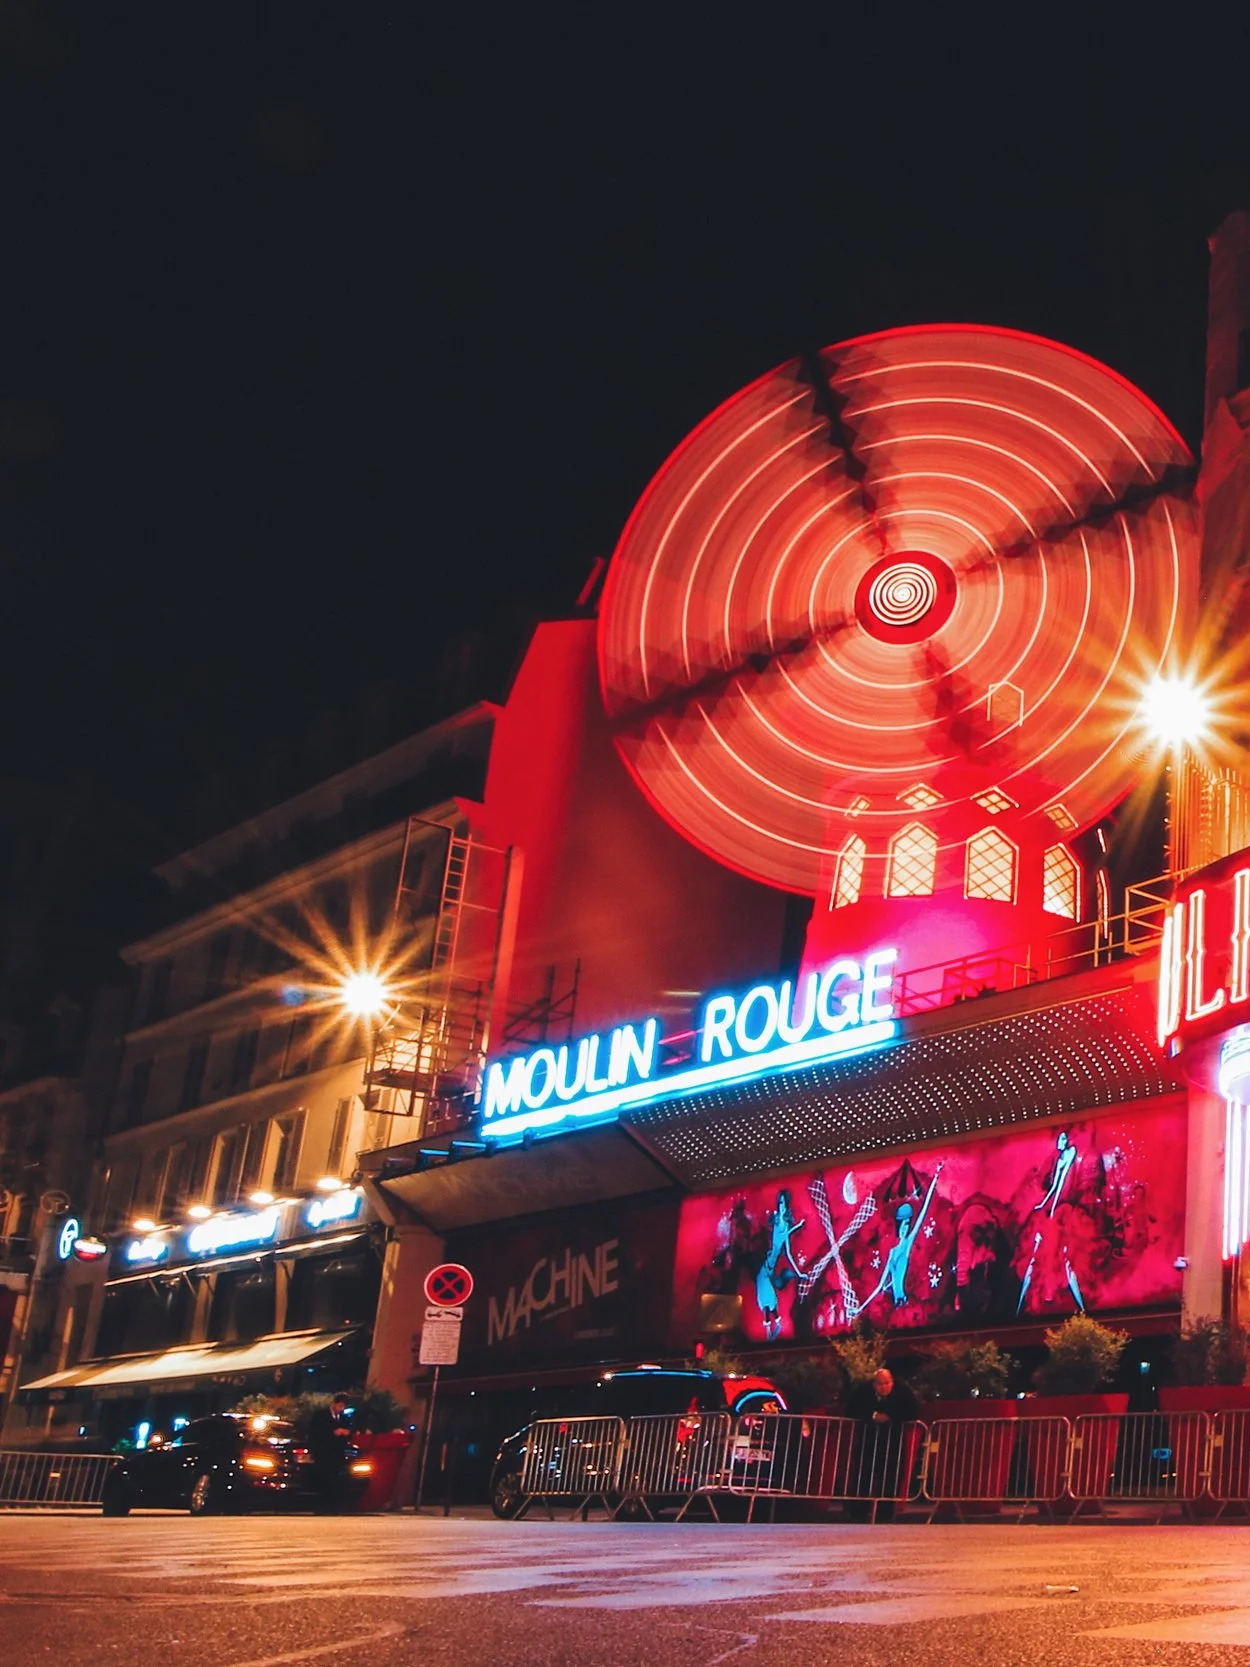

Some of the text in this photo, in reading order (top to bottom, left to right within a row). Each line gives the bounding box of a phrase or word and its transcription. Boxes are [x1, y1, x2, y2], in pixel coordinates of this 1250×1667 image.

[484, 947, 899, 1119] MOULIN ROUGE
[487, 1237, 619, 1346] MACHINE
